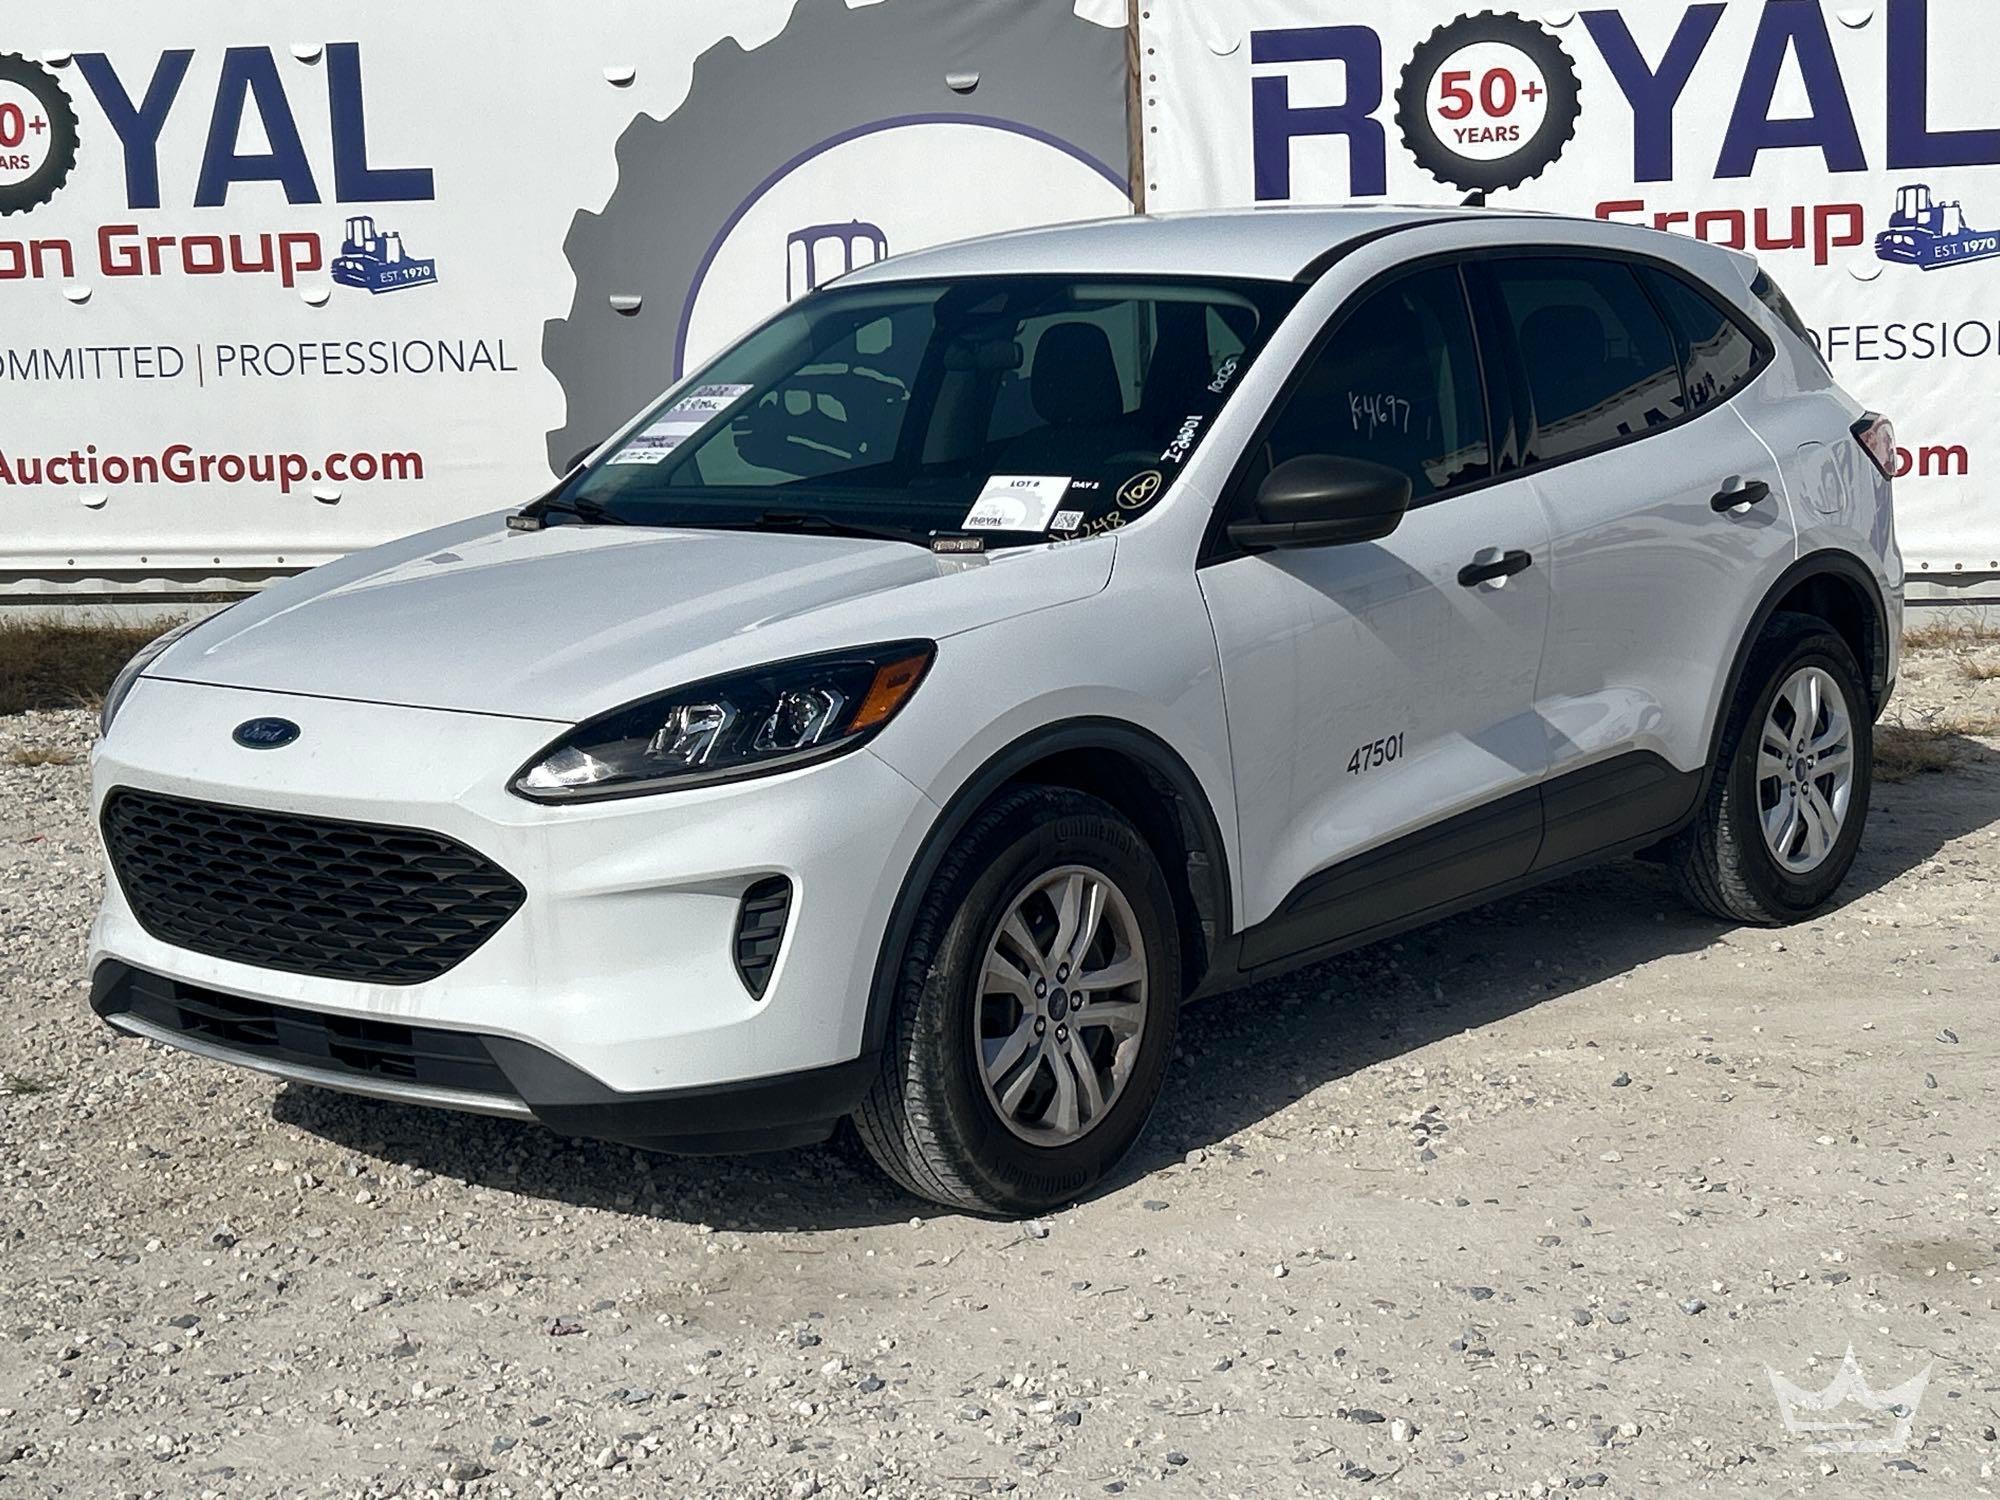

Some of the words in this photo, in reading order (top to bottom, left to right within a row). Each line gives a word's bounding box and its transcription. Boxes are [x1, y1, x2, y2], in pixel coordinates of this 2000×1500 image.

[1438, 67, 1543, 120] 50+
[1453, 125, 1520, 144] YEARS
[97, 224, 323, 287] Group
[1963, 237, 1997, 253] 1970
[402, 265, 431, 279] 1970
[216, 339, 518, 377] PROFESSIONAL
[1010, 480, 1031, 488] LOT
[1346, 731, 1404, 775] 47501
